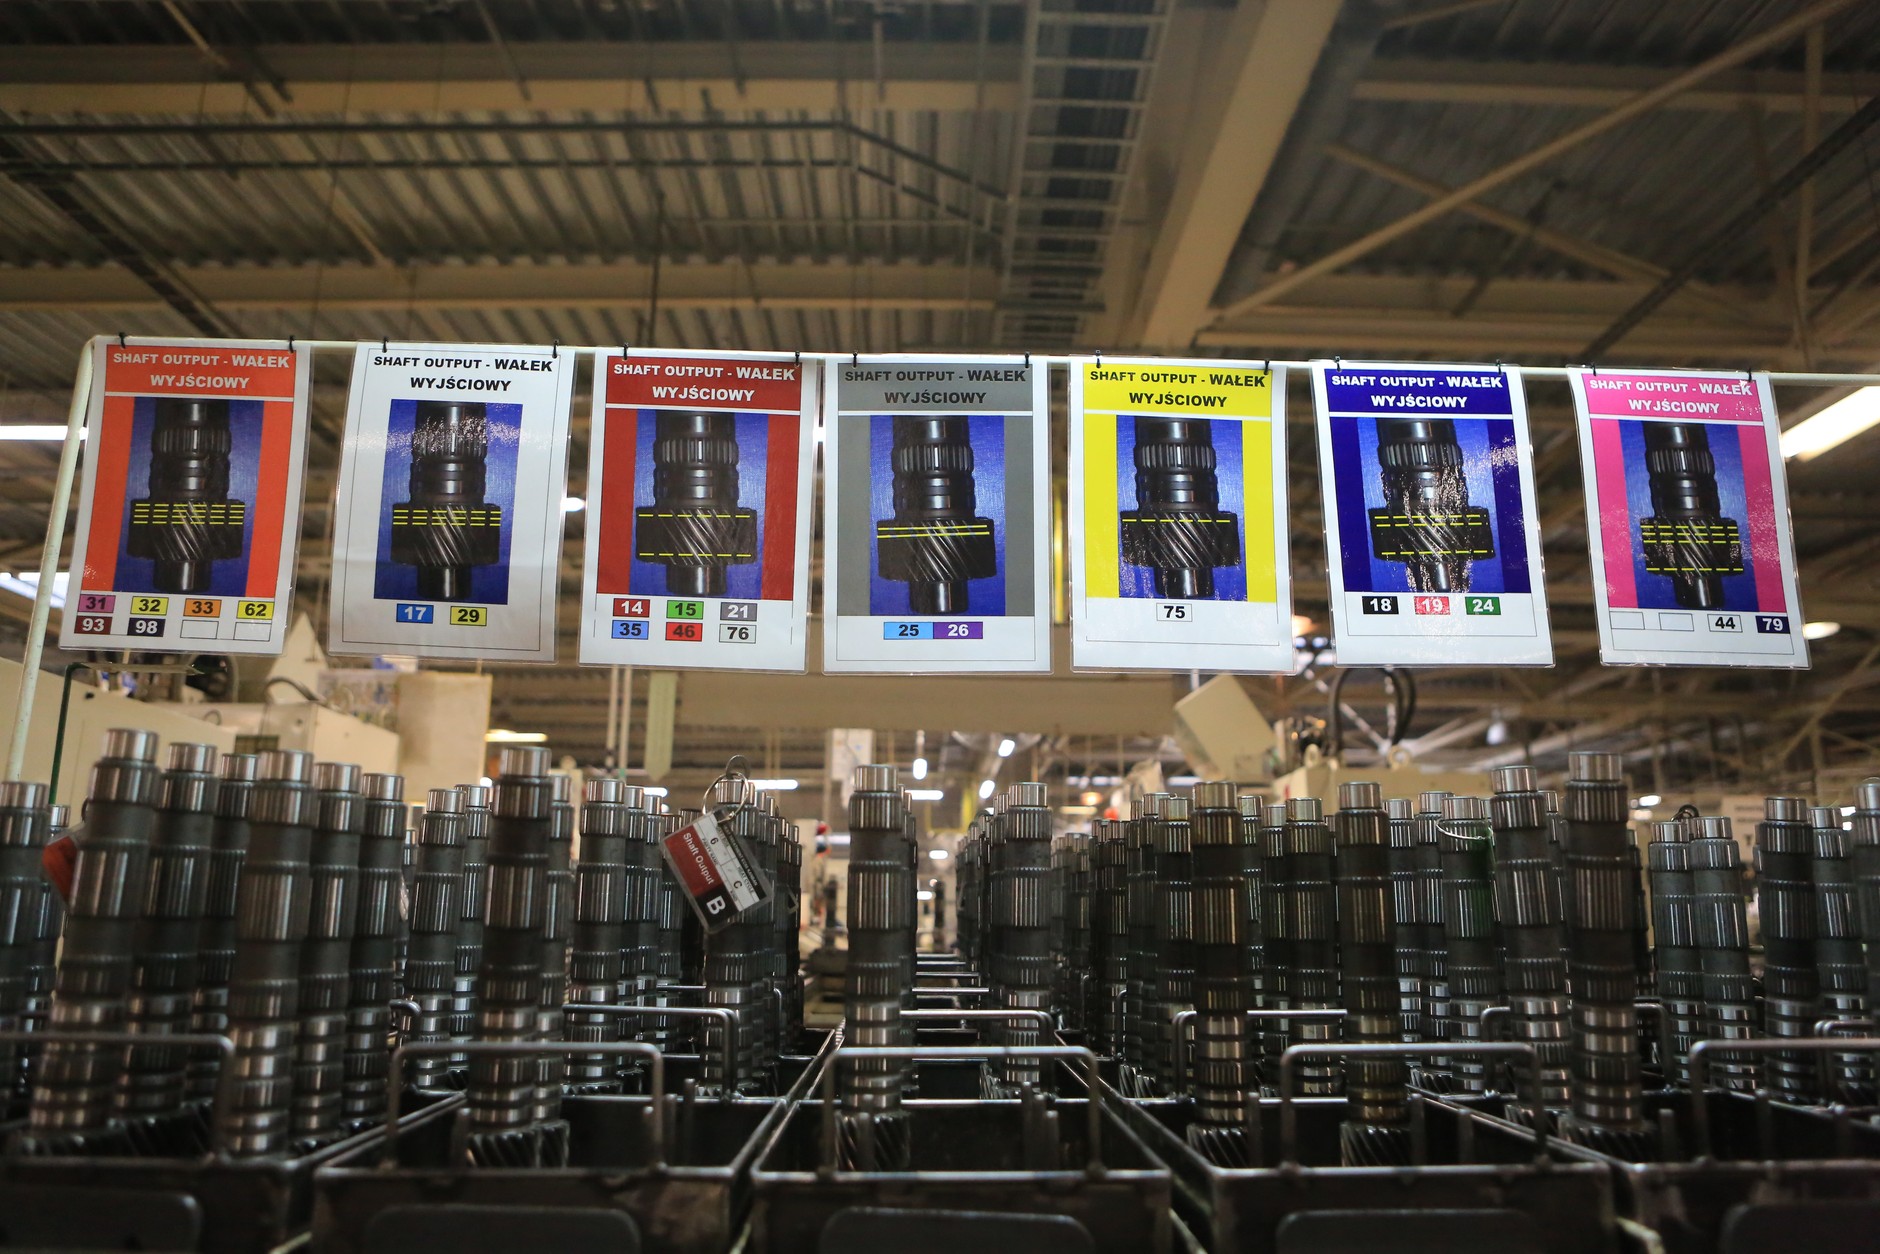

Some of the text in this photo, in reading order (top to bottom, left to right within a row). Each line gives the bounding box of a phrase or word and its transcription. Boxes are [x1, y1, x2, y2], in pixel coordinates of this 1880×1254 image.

[113, 353, 158, 363] SHAFT
[163, 355, 220, 365] OUTPUT
[232, 355, 289, 368] WAŁEK
[374, 357, 420, 367] SHAFT
[424, 358, 482, 368] OUTPUT
[495, 359, 552, 371] WAŁEK
[614, 364, 660, 375] SHAFT
[665, 366, 723, 377] OUTPUT
[736, 367, 795, 380] WAŁEK
[845, 371, 891, 381] SHAFT
[896, 372, 954, 381] OUTPUT
[967, 370, 1026, 381] WAŁEK
[1090, 371, 1136, 381] SHAFT
[1141, 373, 1197, 384] OUTPUT
[1210, 374, 1265, 387] WAŁEK
[150, 373, 250, 388] WYJŚCIOWY
[410, 376, 511, 391] WYJŚCIOWY
[1332, 376, 1376, 386] SHAFT
[1380, 377, 1435, 387] OUTPUT
[1446, 377, 1502, 388] WAŁEK
[1590, 380, 1631, 390] SHAFT
[1636, 382, 1688, 392] OUTPUT
[1699, 383, 1752, 395] WAŁEK
[652, 385, 755, 401] WYJŚCIOWY
[885, 390, 986, 403] WYJŚCIOWY
[1129, 392, 1227, 407] WYJŚCIOWY
[1371, 394, 1467, 407] WYJŚCIOWY
[1629, 399, 1719, 413] WYJŚCIOWY
[86, 597, 267, 616] 31 32 33 62
[621, 601, 749, 618] 14 15 21
[1164, 606, 1185, 618] 75
[1370, 598, 1494, 612] 18 19 24
[405, 606, 479, 622] 17 29
[83, 619, 158, 634] 93 98
[899, 624, 969, 636] 25 26
[1715, 617, 1783, 630] 44 79
[619, 623, 749, 640] 35 46 76
[683, 833, 714, 884] Shaft Output
[734, 881, 742, 889] C
[706, 896, 725, 914] B
